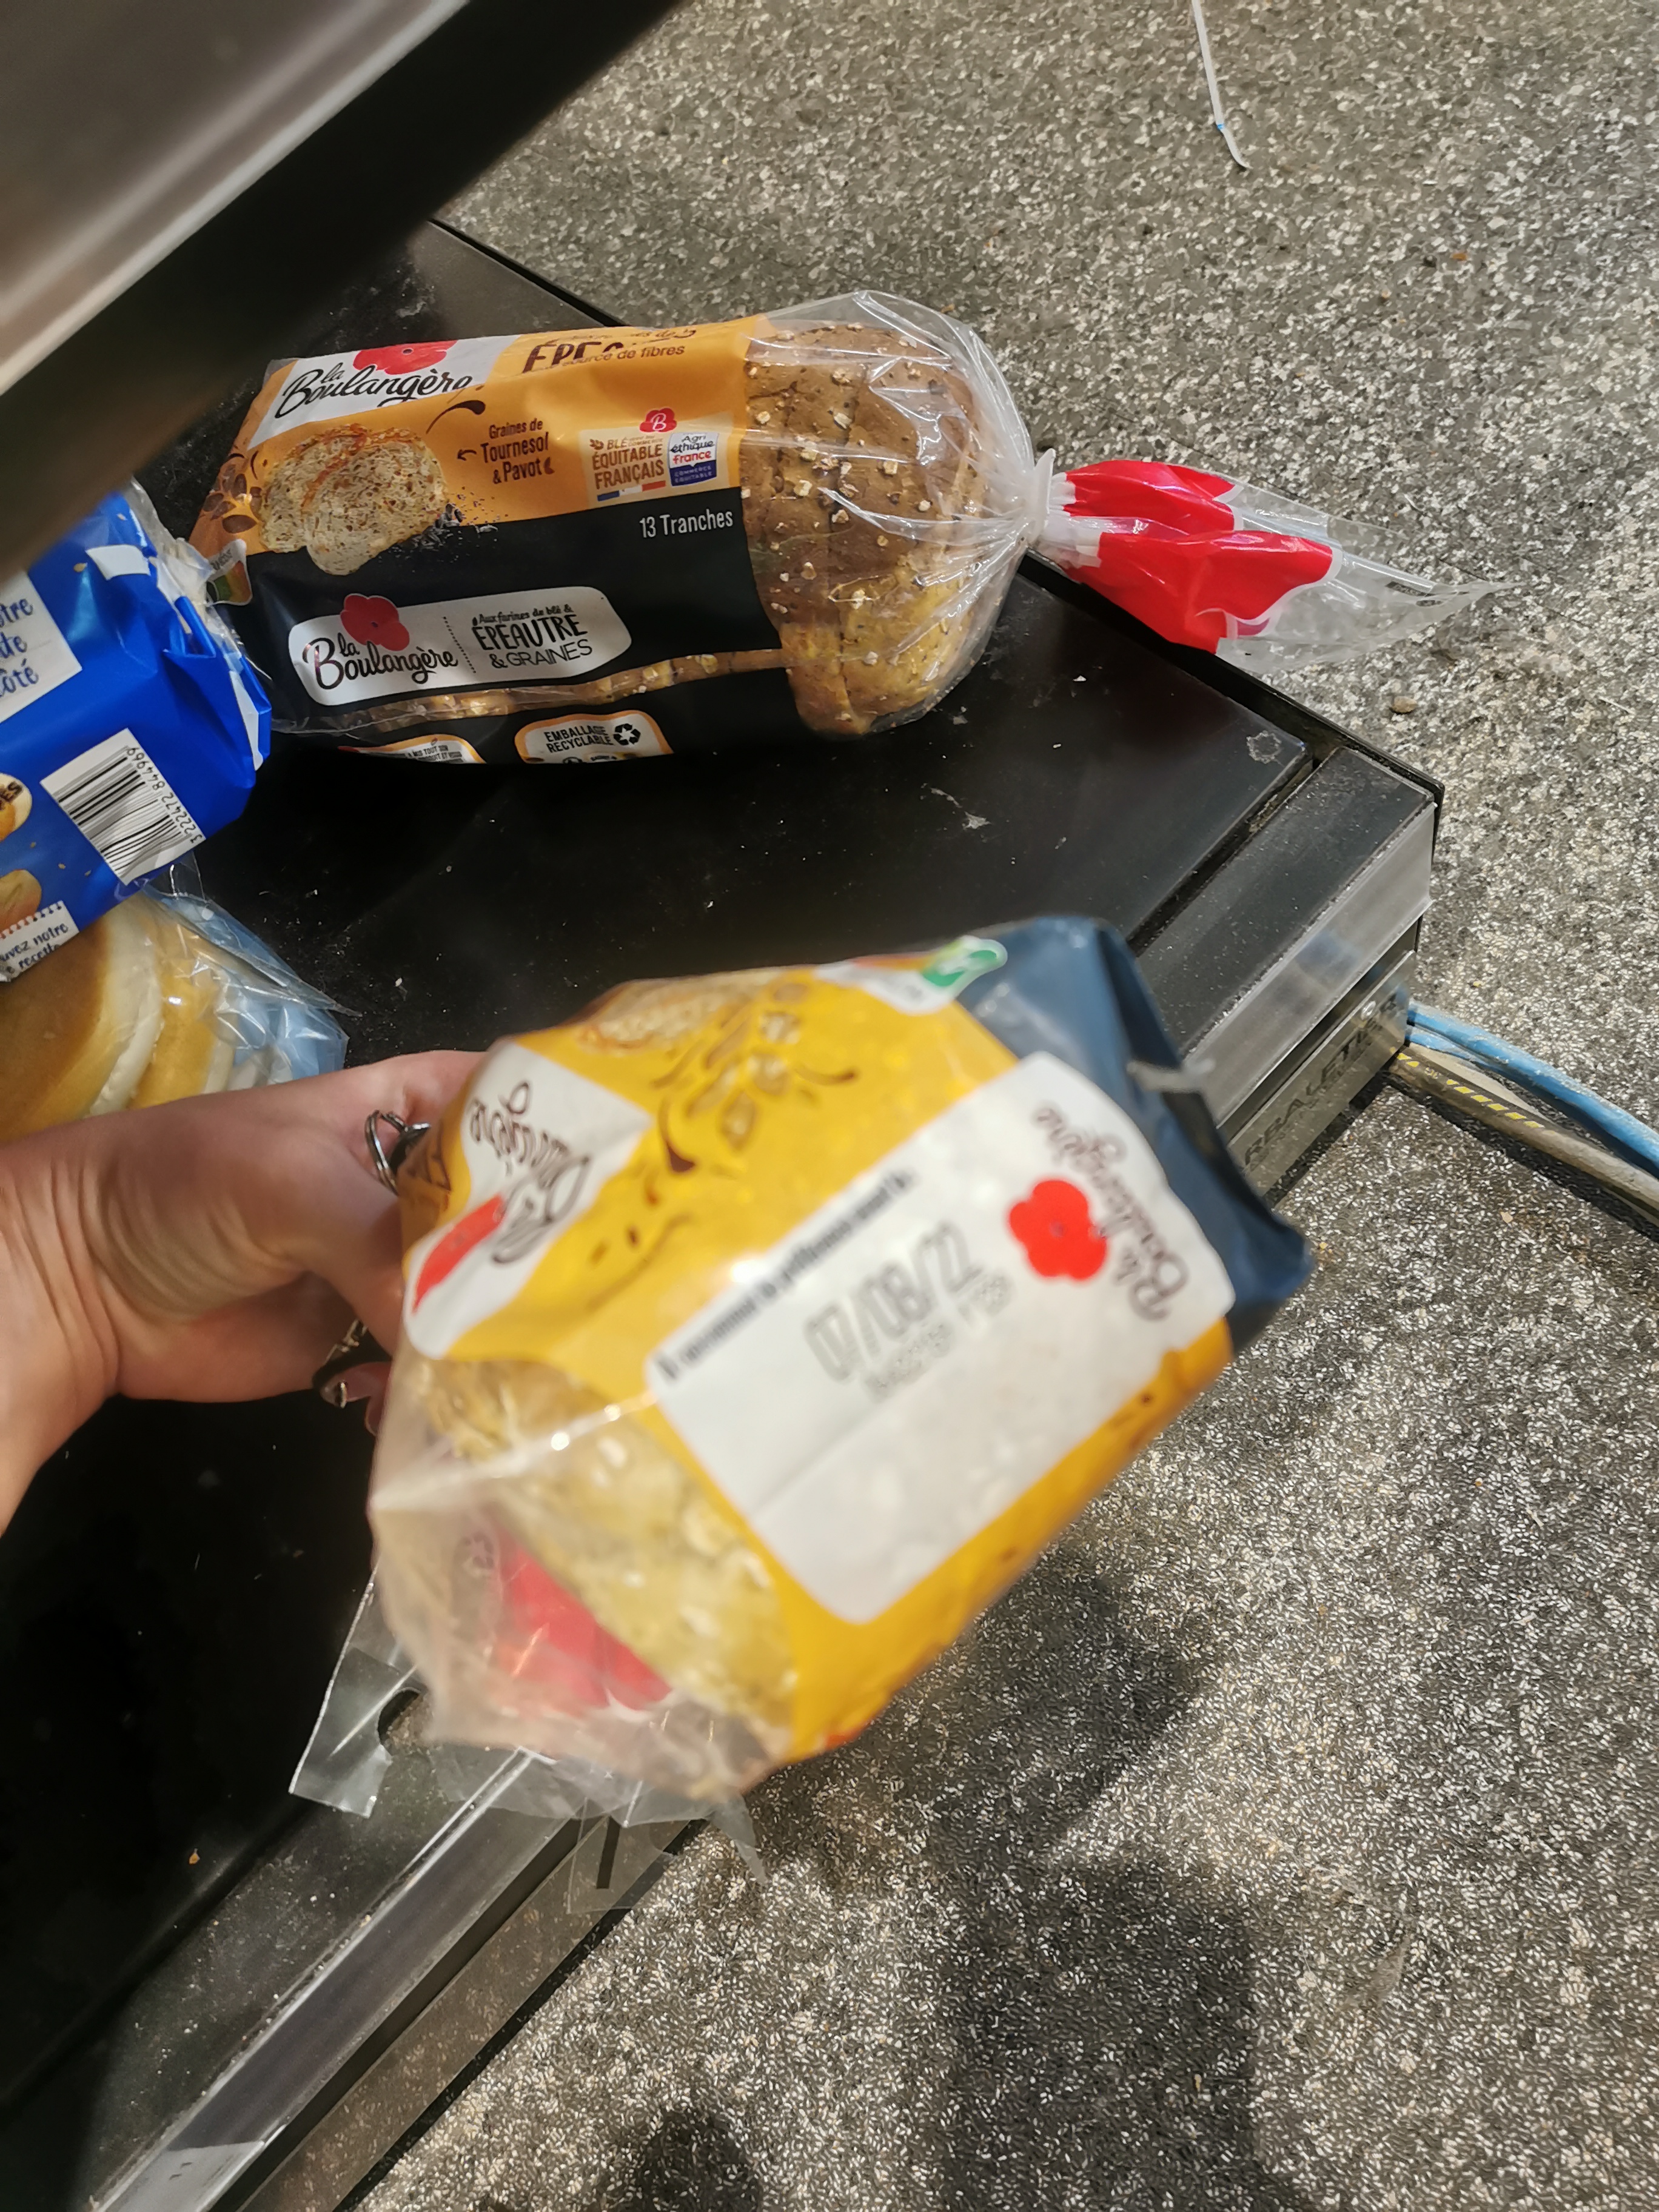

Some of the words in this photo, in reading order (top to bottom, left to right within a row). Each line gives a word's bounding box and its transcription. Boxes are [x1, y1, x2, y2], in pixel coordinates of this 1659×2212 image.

[617, 347, 637, 360] de
[641, 344, 685, 358] fibres
[320, 363, 345, 384] la
[489, 423, 527, 439] Graines
[529, 417, 543, 431] de
[480, 431, 549, 463] Tournesol
[607, 436, 628, 451] BLÉ
[671, 440, 715, 454] éthique
[681, 435, 706, 444] Agri
[591, 443, 663, 471] ÉQUITABLE
[672, 451, 712, 465] france
[492, 469, 502, 484] &
[503, 458, 543, 483] Pavot
[594, 459, 665, 490] FRANÇAIS
[639, 517, 656, 538] 13
[660, 508, 734, 535] Tranches
[532, 608, 544, 617] de
[472, 614, 588, 651] ÉPEAUTRE
[337, 632, 360, 657] la
[489, 653, 508, 669] &
[506, 638, 593, 666] GRAINES
[302, 637, 458, 690] Boulangère
[544, 725, 609, 743] EMBALLAGE
[546, 735, 615, 753] RECYCLABLE
[423, 745, 437, 755] TOUT
[126, 746, 166, 791] 844969
[161, 791, 196, 835] 222472
[190, 834, 203, 843] 3
[33, 923, 69, 946] notre
